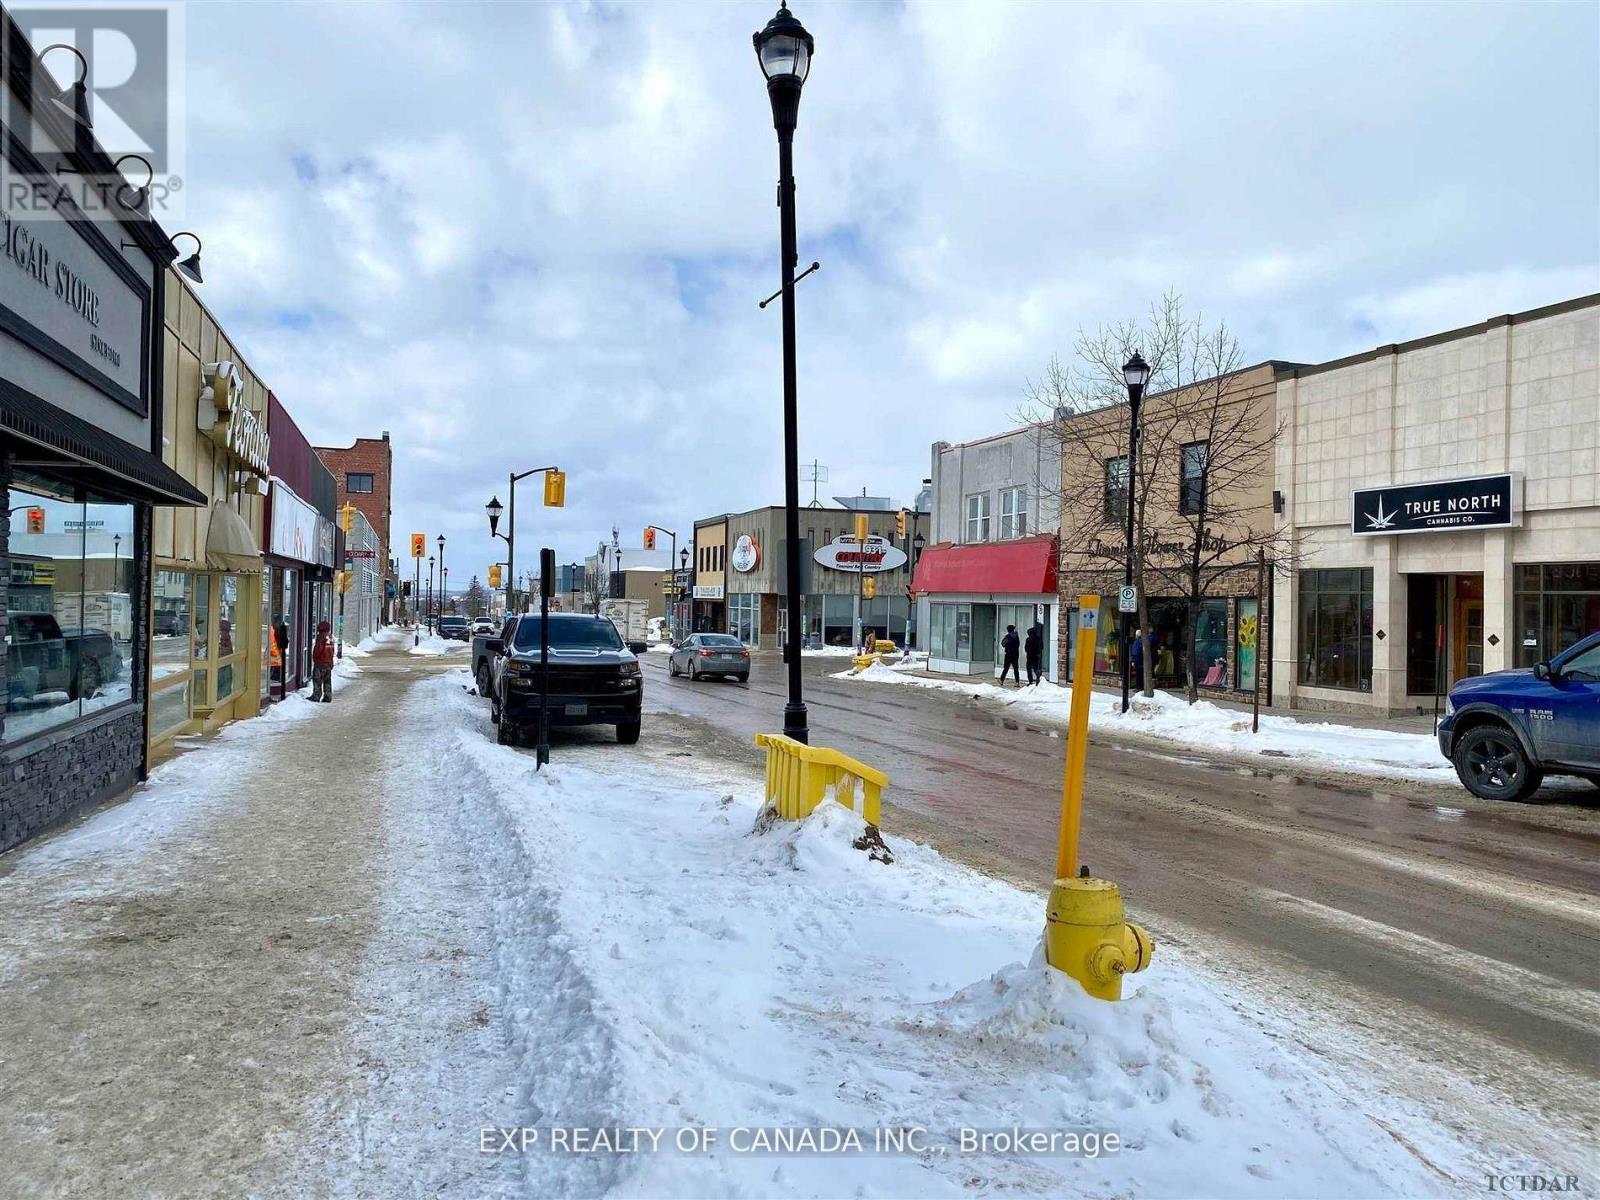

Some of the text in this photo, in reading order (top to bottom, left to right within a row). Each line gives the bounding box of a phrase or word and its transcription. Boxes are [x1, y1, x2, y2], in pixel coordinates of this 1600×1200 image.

[55, 260, 99, 328] STORE
[1404, 494, 1501, 514] TRUE NORTH
[1426, 517, 1460, 525] CANNABIS
